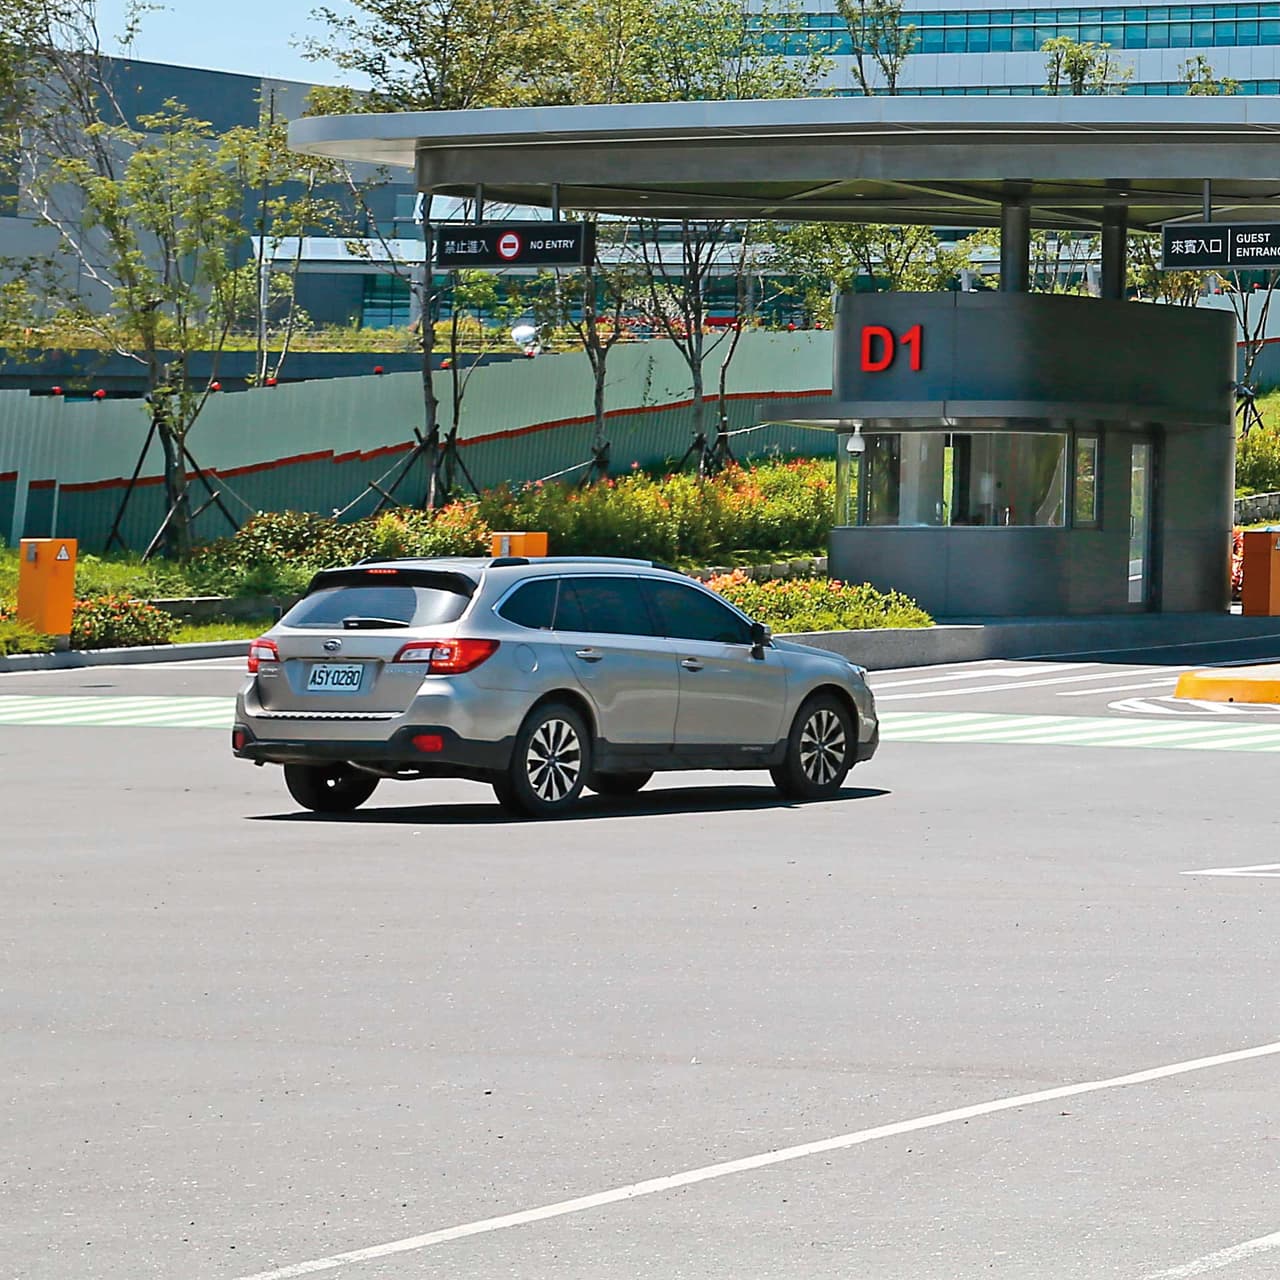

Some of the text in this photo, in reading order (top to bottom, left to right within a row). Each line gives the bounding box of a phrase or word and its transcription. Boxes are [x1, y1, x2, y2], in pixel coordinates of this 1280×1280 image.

[530, 238, 575, 250] NO ENTRY
[1236, 233, 1271, 244] GUEST
[444, 239, 489, 254] 禁止進入
[1171, 239, 1222, 254] 來賓入口
[861, 324, 921, 372] D1
